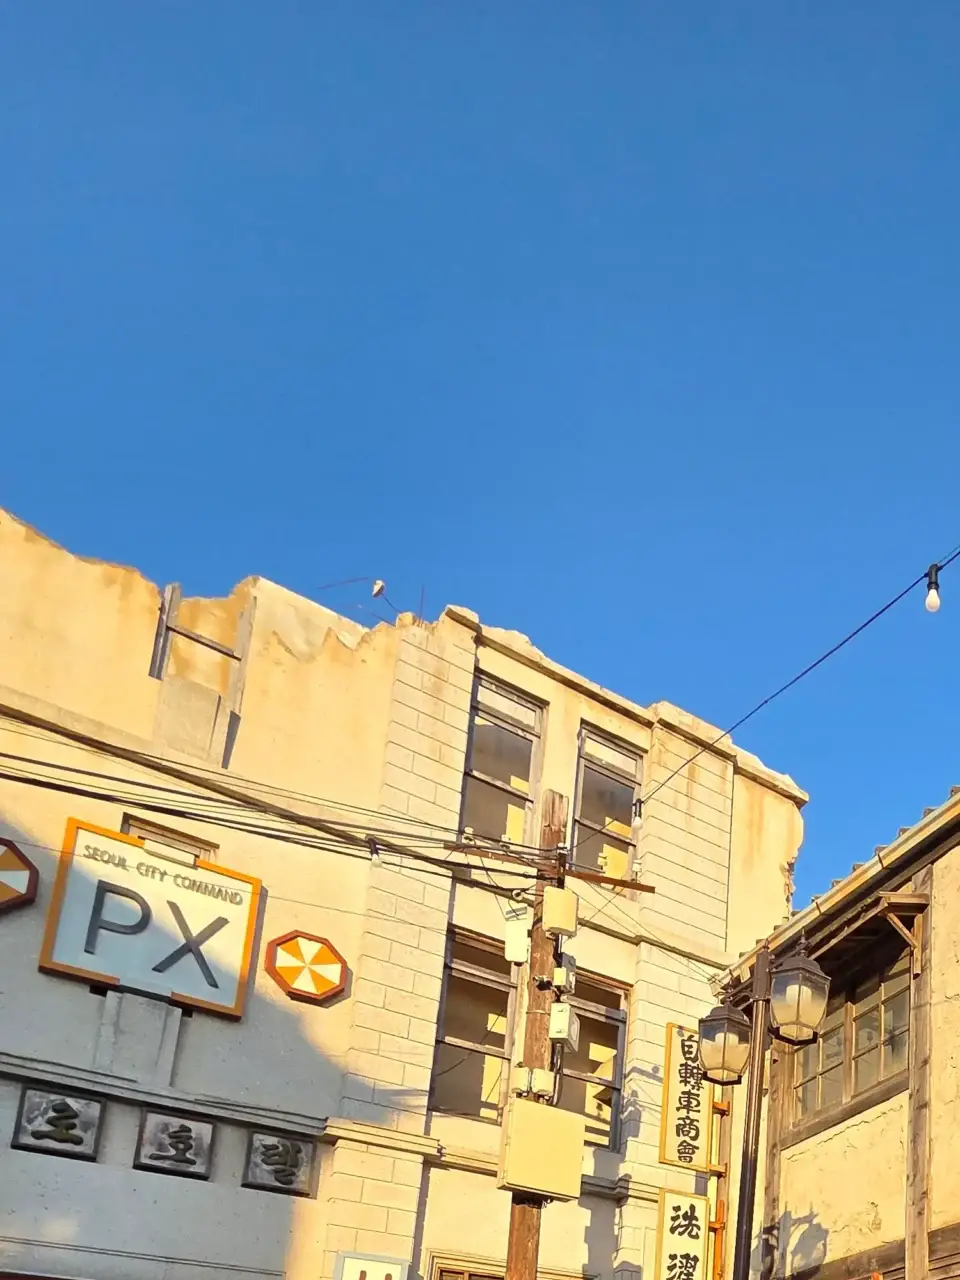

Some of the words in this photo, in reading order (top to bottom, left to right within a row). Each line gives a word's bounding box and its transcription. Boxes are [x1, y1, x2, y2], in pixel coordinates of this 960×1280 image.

[83, 845, 130, 872] SEOUL
[136, 861, 168, 883] CITY
[173, 873, 244, 906] COMMAND
[84, 880, 229, 990] PX
